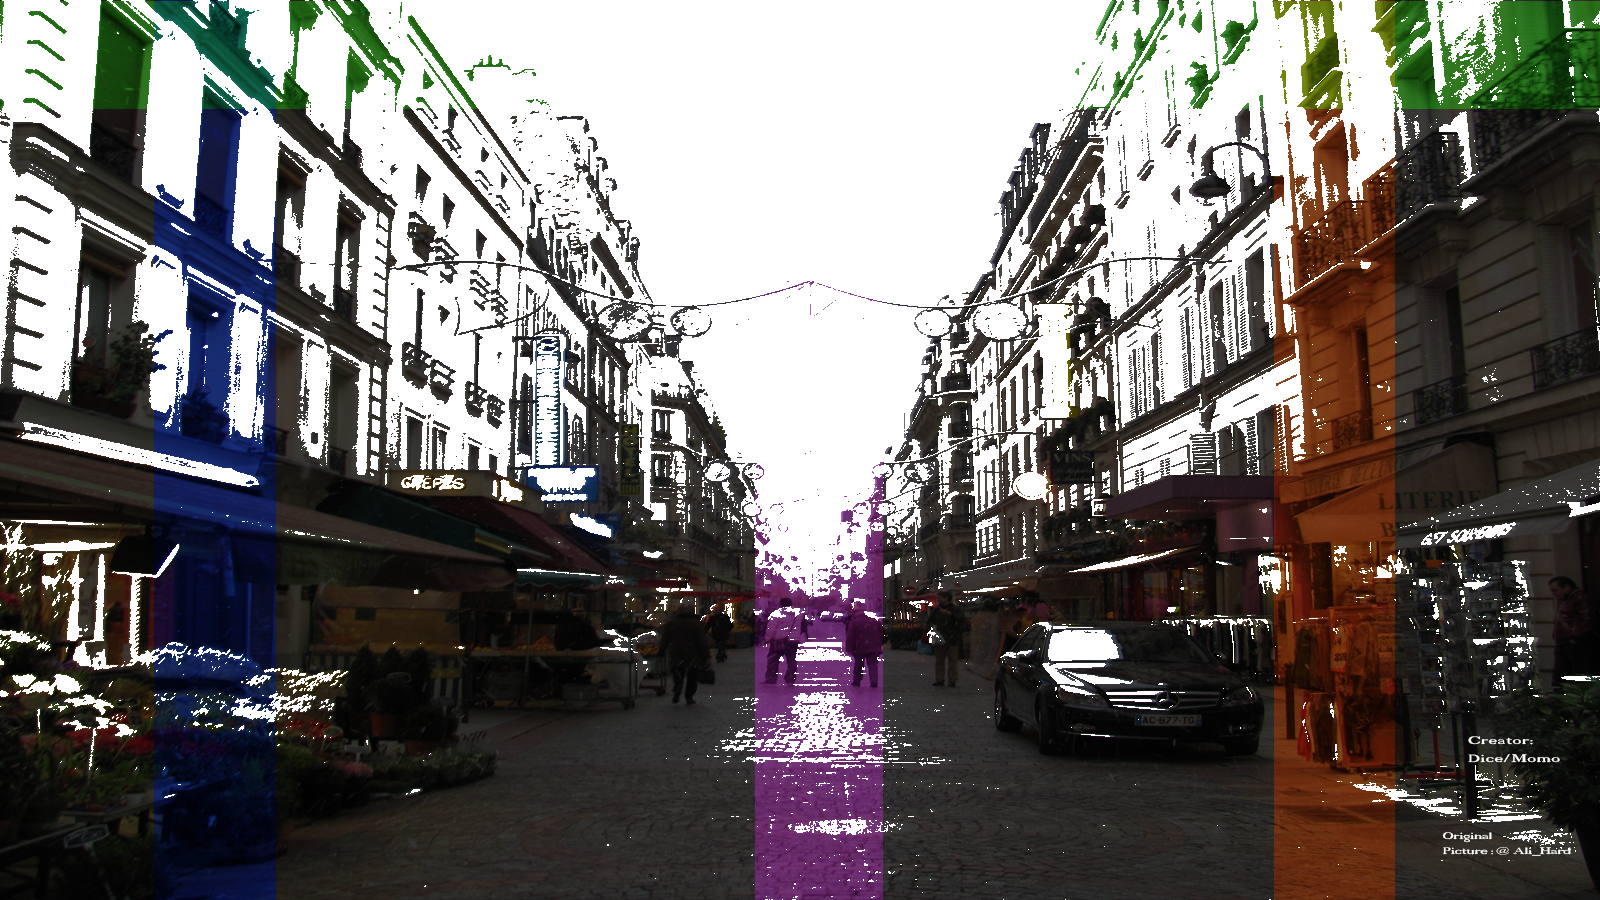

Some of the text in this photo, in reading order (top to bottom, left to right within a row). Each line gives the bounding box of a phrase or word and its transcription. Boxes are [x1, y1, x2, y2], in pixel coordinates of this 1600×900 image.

[622, 426, 639, 478] HOTEL
[1053, 452, 1092, 463] VINS
[1006, 563, 1026, 573] PETIT
